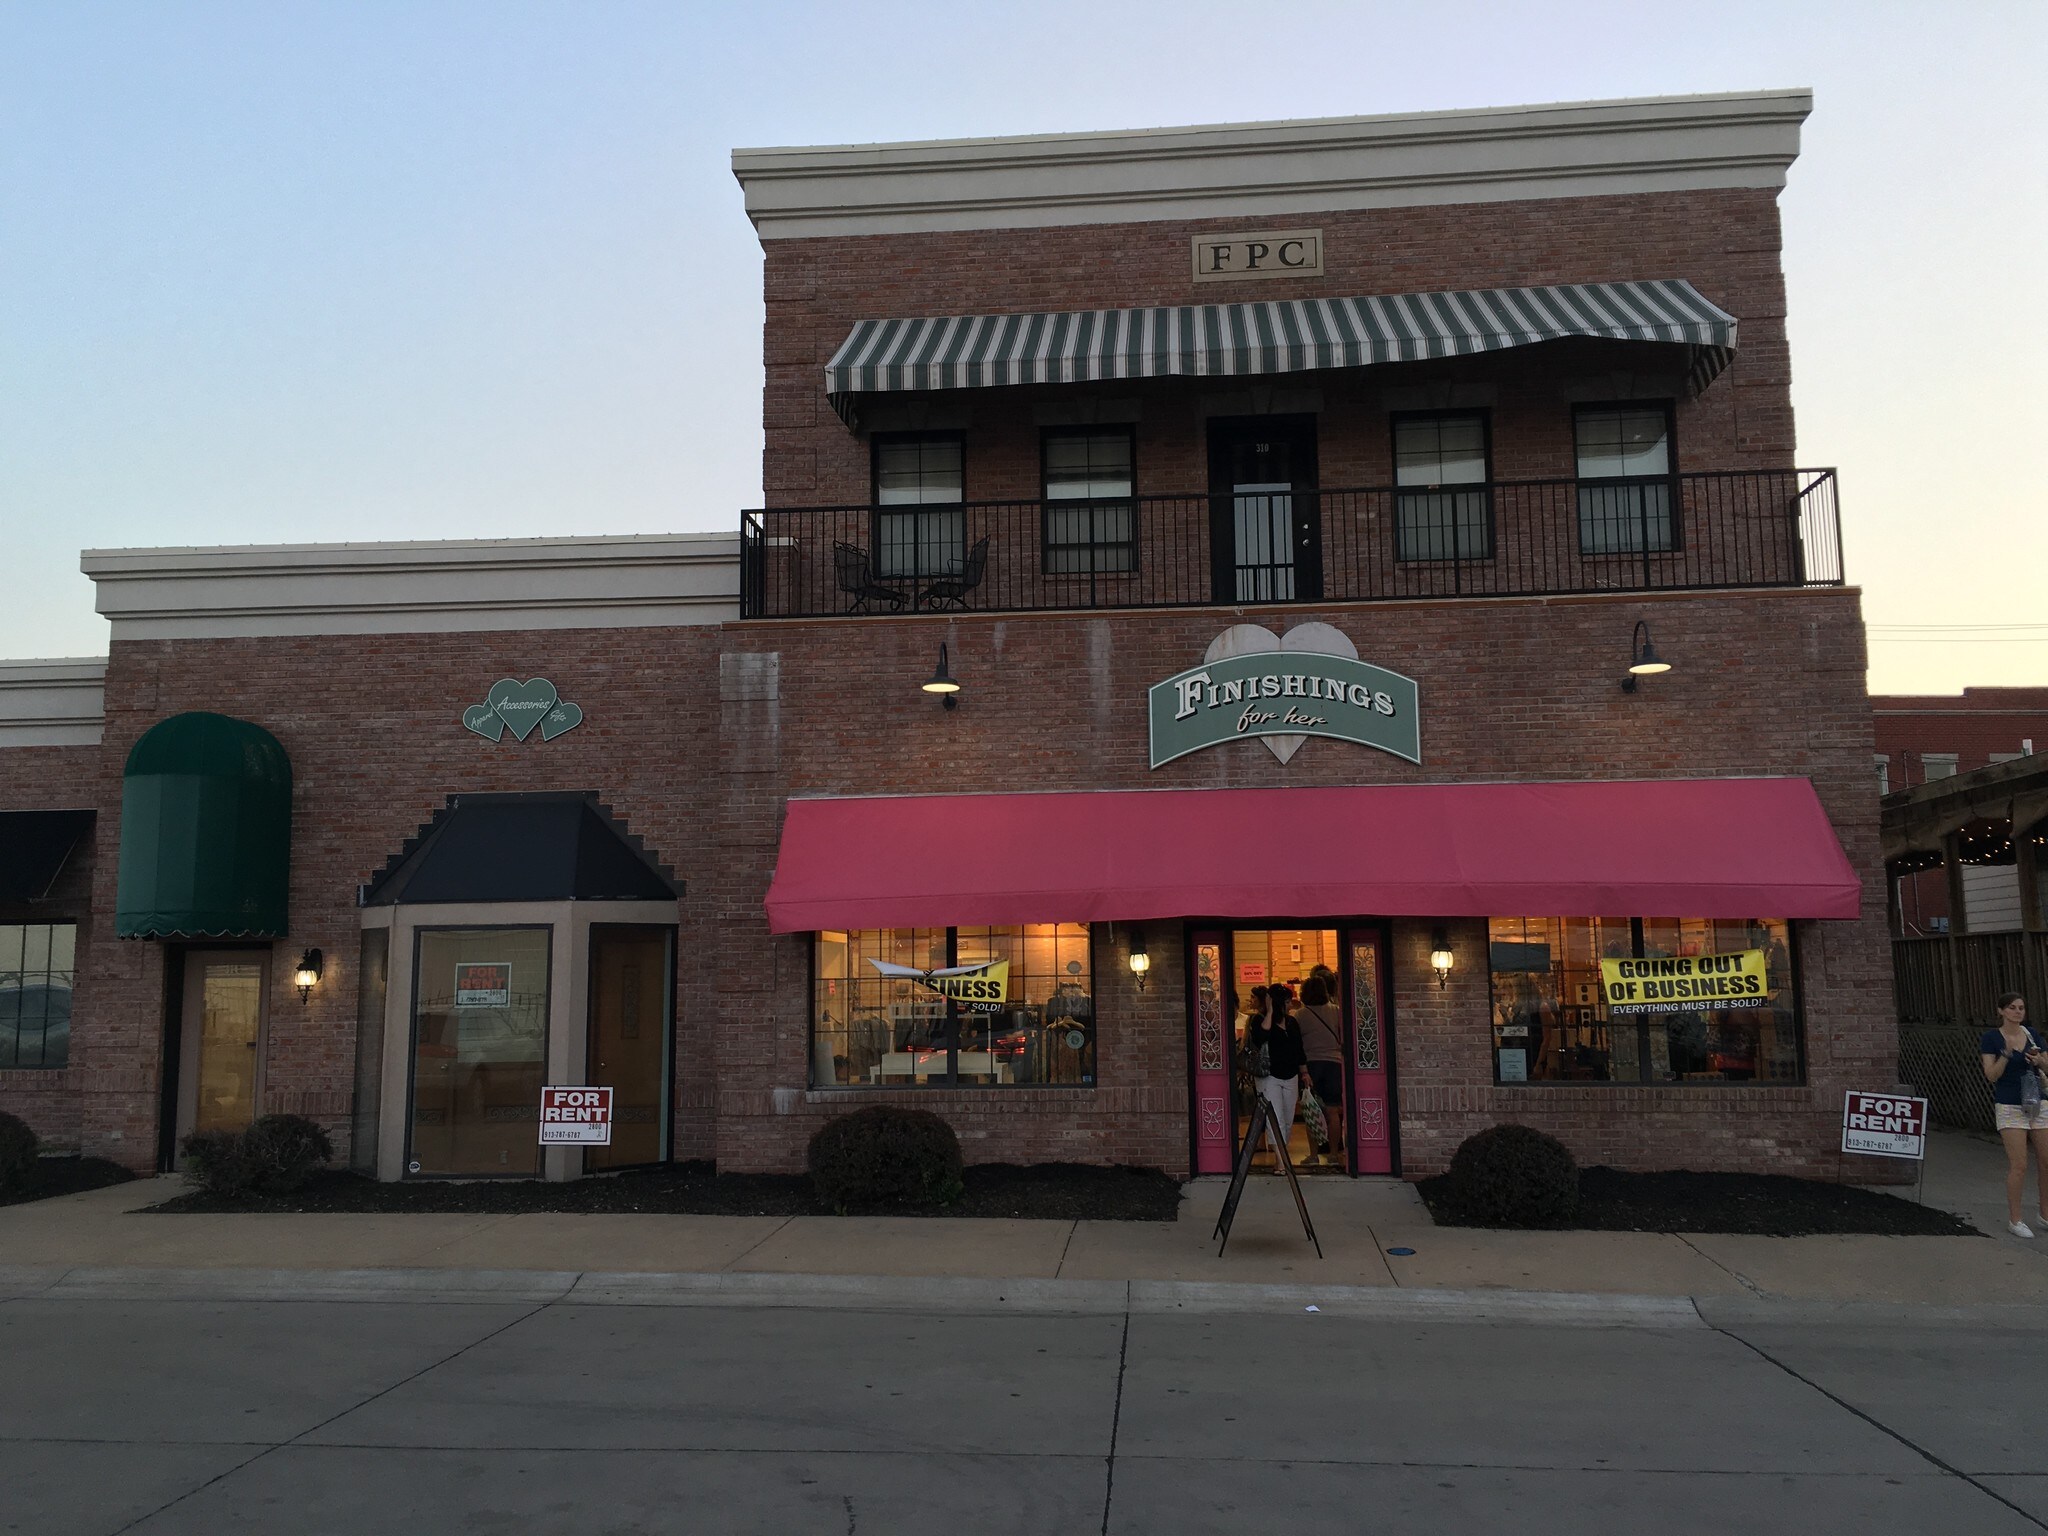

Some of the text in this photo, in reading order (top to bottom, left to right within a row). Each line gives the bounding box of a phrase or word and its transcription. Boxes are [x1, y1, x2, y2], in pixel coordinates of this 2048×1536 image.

[497, 696, 550, 710] Accessories
[1174, 671, 1396, 720] FINISHINGS
[1236, 703, 1327, 732] for her
[467, 966, 497, 978] FOR
[1618, 954, 1744, 979] GOING OUT
[459, 977, 505, 989] RENT
[1609, 974, 1760, 1001] OF BUSINESS
[971, 1002, 1001, 1012] SOLD!
[1613, 998, 1763, 1014] EVERYTHING MUST BE SOLD!
[553, 1092, 600, 1107] FOR
[1859, 1098, 1912, 1117] FOR
[545, 1107, 607, 1122] RENT
[1849, 1113, 1920, 1133] RENT
